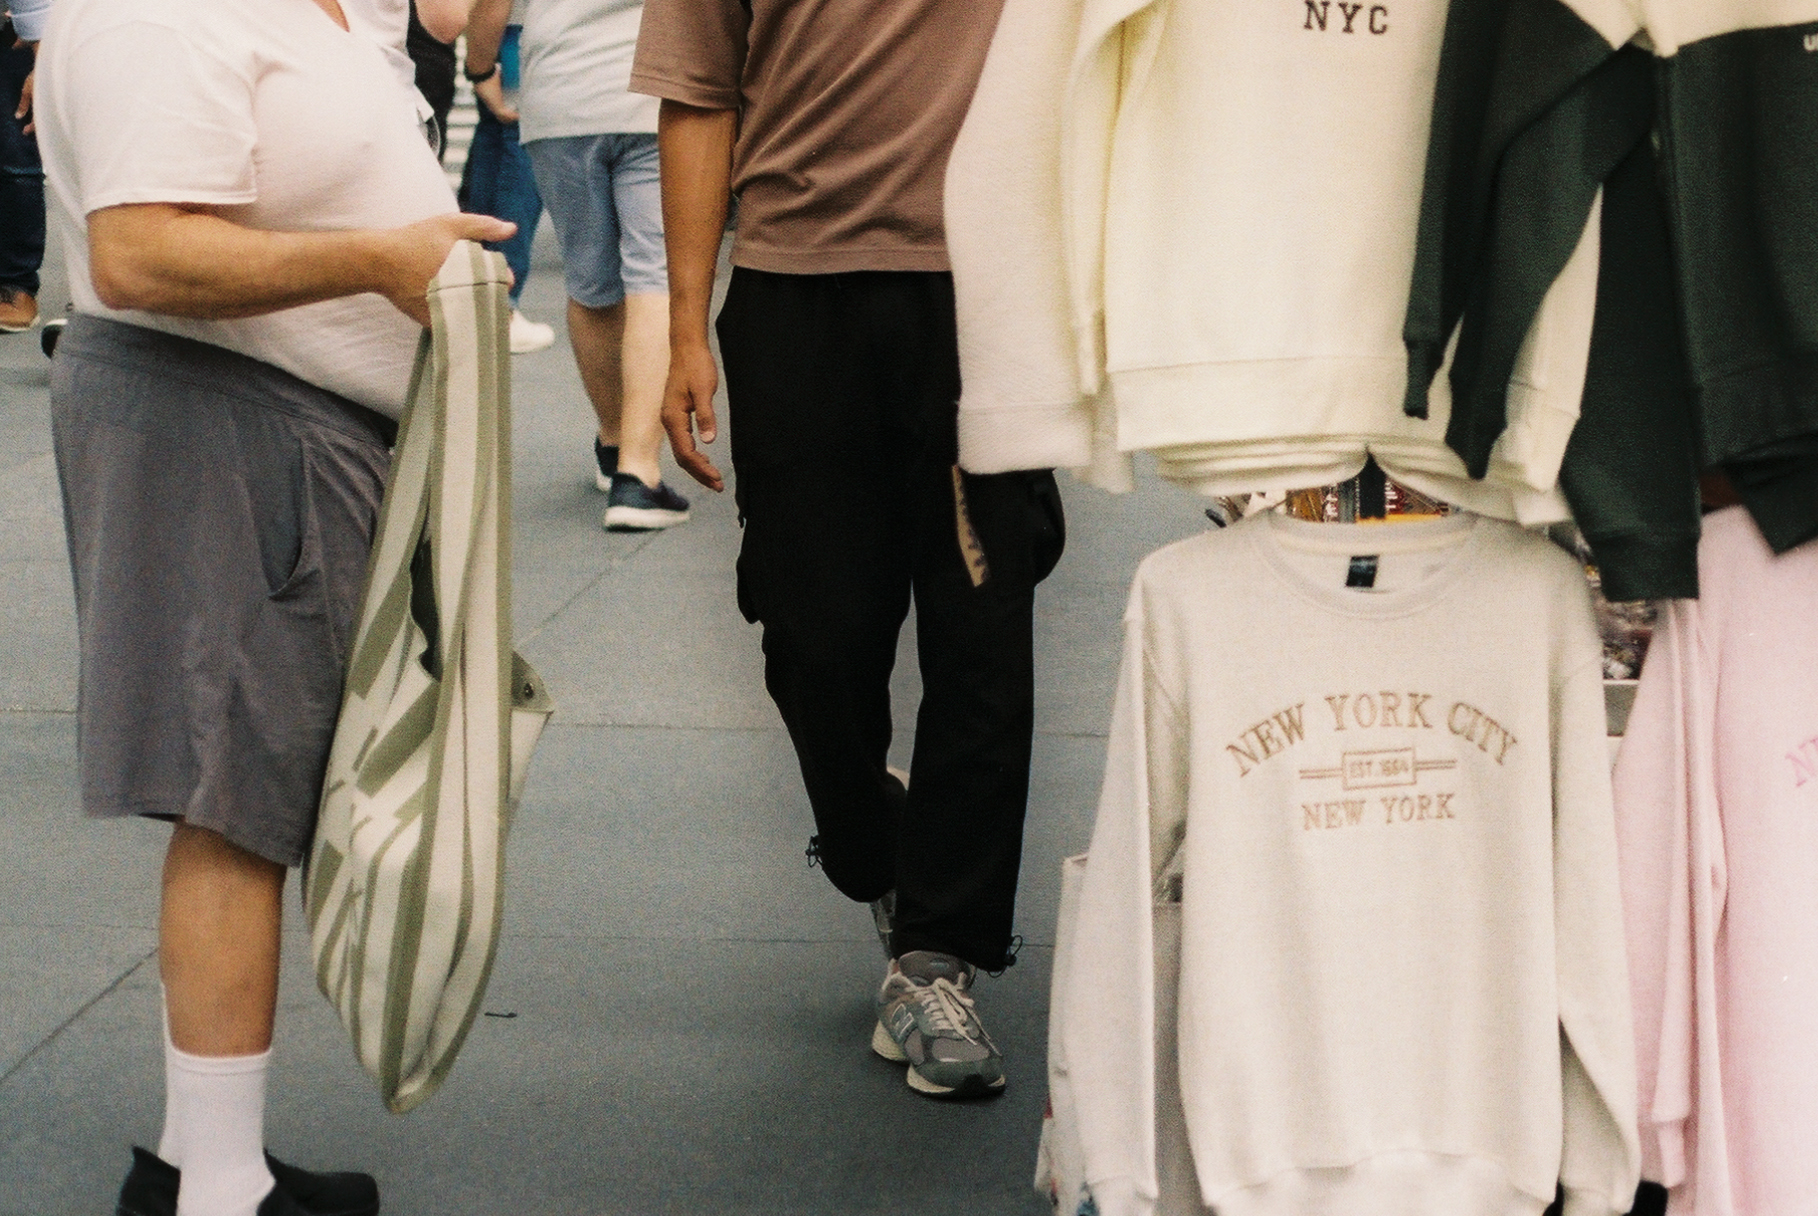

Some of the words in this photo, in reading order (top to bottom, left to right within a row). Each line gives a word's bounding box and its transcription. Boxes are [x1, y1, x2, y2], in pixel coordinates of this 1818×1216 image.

[1303, 0, 1390, 35] NYC
[1226, 702, 1306, 779] NEW
[1324, 690, 1434, 732] YORK
[1447, 700, 1519, 767] CITY
[1301, 799, 1367, 832] NEW
[1381, 793, 1456, 825] YORK
